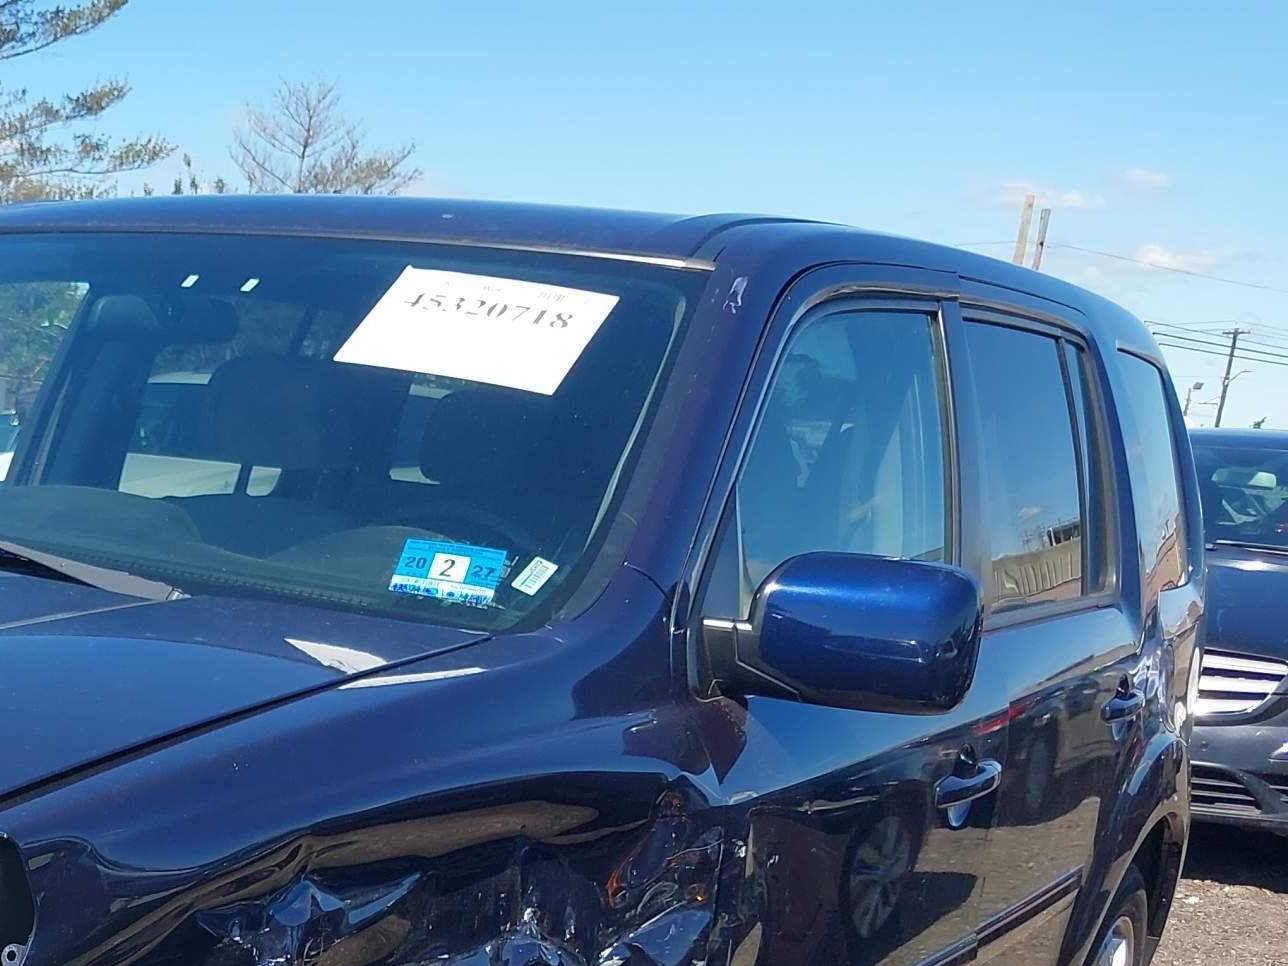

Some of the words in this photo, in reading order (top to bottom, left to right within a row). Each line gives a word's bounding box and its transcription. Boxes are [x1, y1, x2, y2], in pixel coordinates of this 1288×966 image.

[404, 292, 574, 329] 45320718
[405, 555, 427, 570] 20
[438, 558, 457, 578] 2
[471, 564, 498, 579] 27
